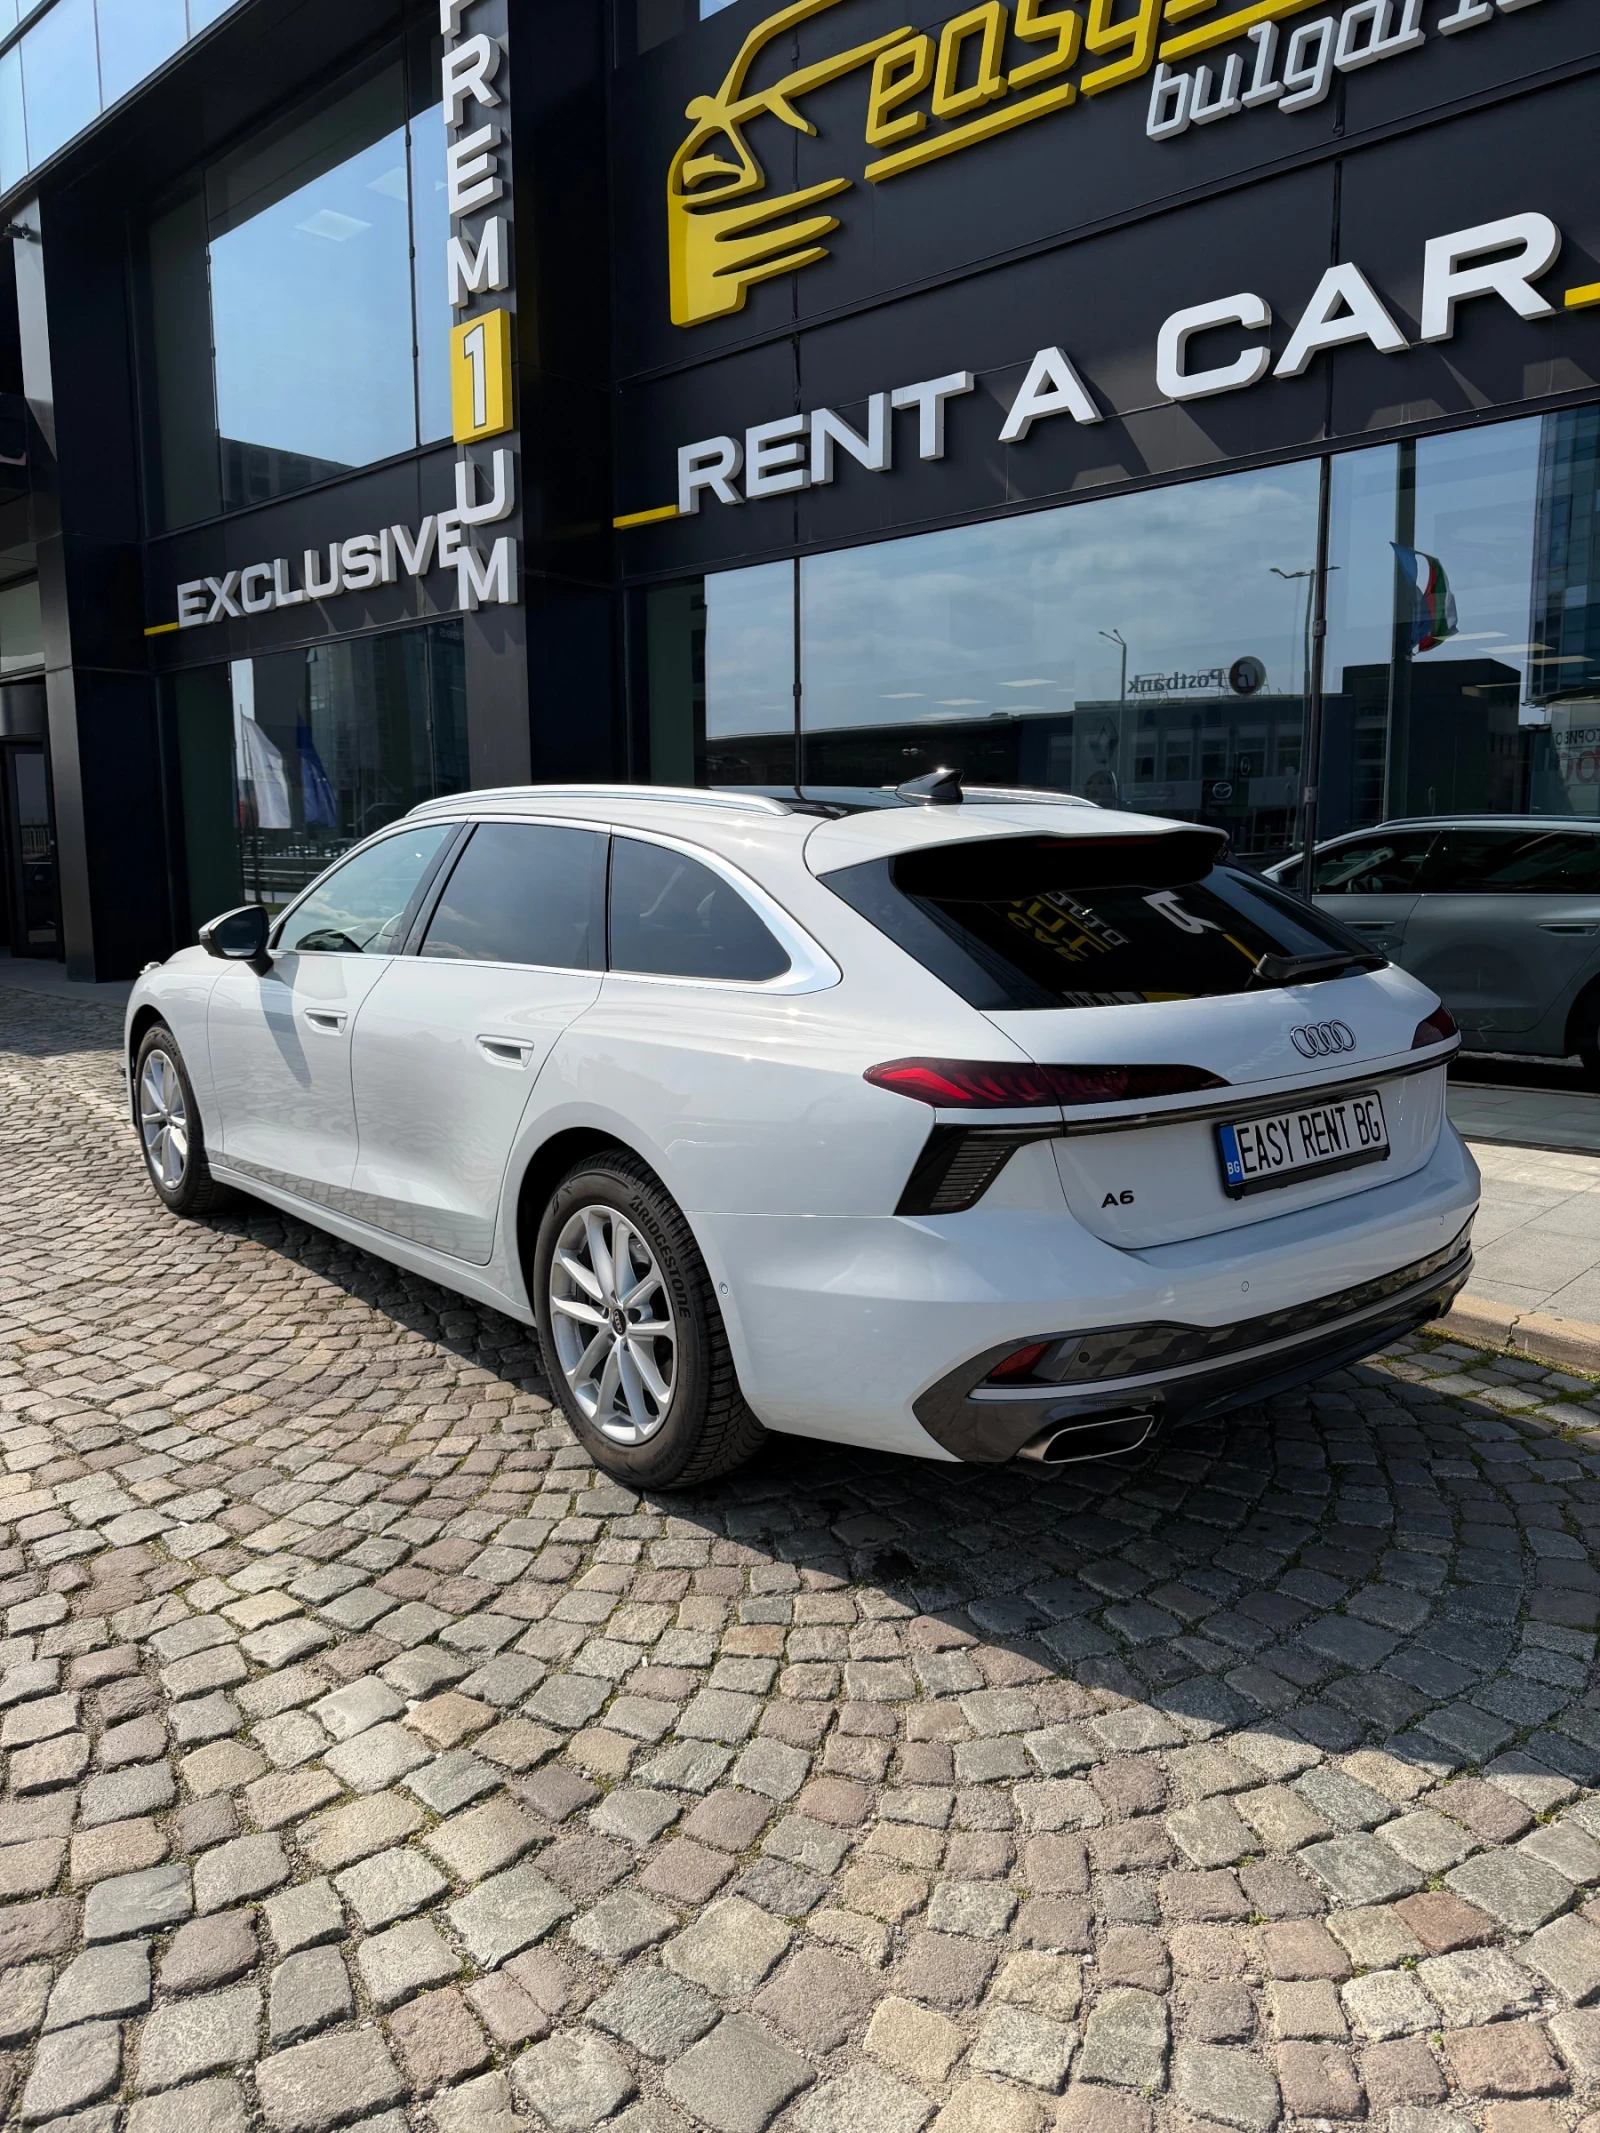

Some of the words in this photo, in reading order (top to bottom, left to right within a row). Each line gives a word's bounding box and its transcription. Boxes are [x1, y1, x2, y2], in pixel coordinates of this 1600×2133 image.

[677, 370, 974, 516] RENT
[998, 345, 1105, 441] A
[1155, 211, 1562, 400] CAR
[177, 509, 462, 628] EXCLUSIVE
[1227, 1161, 1240, 1175] BG
[1236, 1119, 1293, 1173] EASY
[1298, 1106, 1350, 1158] RENT
[1353, 1101, 1381, 1146] BG
[1101, 1190, 1135, 1209] A6
[629, 1194, 691, 1319] BRIDGESTONE
